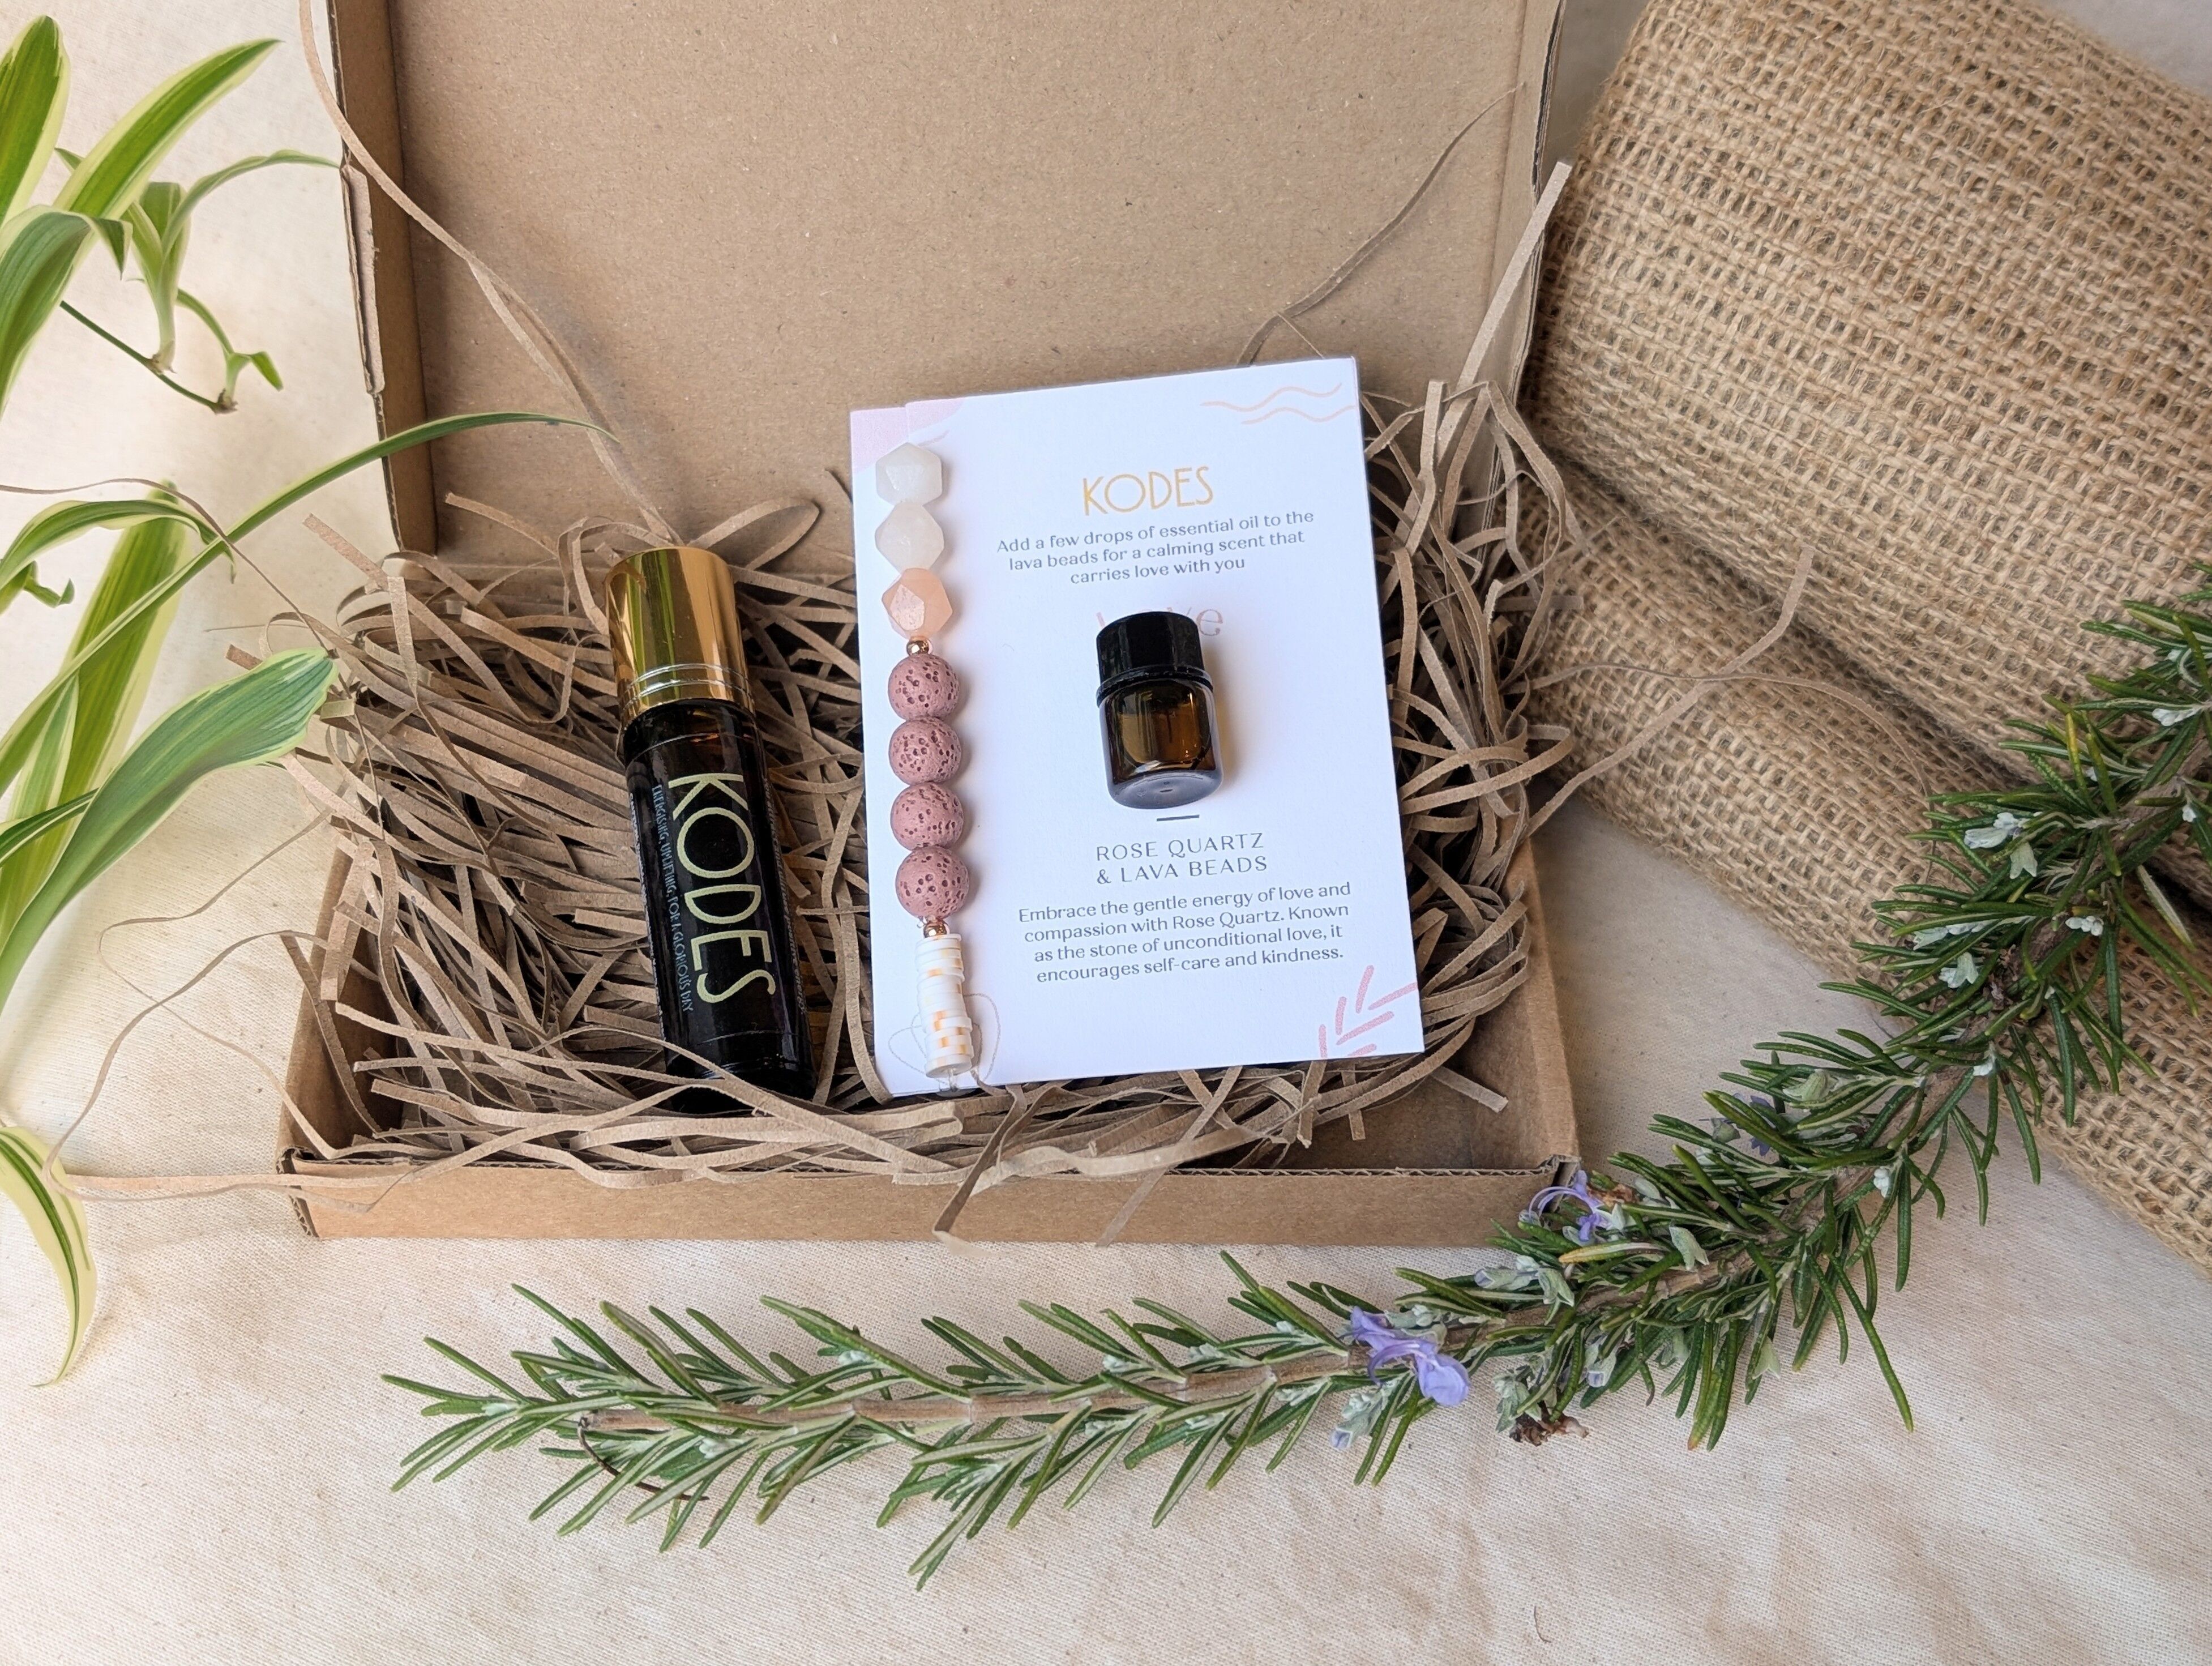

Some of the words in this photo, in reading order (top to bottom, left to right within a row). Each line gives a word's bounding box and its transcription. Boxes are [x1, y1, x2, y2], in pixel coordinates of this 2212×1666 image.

[1083, 467, 1213, 515] KODES
[996, 537, 1030, 553] Add
[1035, 539, 1045, 549] a
[1050, 535, 1080, 548] few
[1084, 531, 1133, 545] drops
[1137, 526, 1155, 540] of
[1159, 518, 1234, 538] essential
[1239, 515, 1259, 530] oil
[1264, 515, 1281, 527] to
[1286, 511, 1314, 525] the
[1009, 558, 1042, 571] lava
[1047, 550, 1098, 567] beads
[1102, 549, 1128, 562] for
[1132, 549, 1141, 559] a
[1146, 541, 1214, 558] calming
[1218, 535, 1266, 552] scent
[1269, 531, 1305, 546] that
[1070, 568, 1131, 584] carries
[1135, 565, 1169, 578] love
[1173, 559, 1210, 574] with
[1214, 558, 1245, 574] you
[1097, 841, 1158, 861] ROSE
[1168, 832, 1264, 858] QUARTZ
[668, 773, 776, 1003] KODES
[1097, 869, 1112, 885] &
[1120, 863, 1179, 883] LAVA
[1188, 856, 1267, 877] BEADS
[1019, 905, 1097, 922] Embrace
[1101, 900, 1129, 916] the
[1133, 895, 1187, 916] gentle
[1192, 893, 1253, 908] energy
[1257, 887, 1276, 903] of
[1278, 886, 1314, 900] love
[1318, 881, 1351, 898] and
[1024, 922, 1127, 943] compassion
[1131, 917, 1168, 933] with
[1173, 915, 1215, 929] Rose
[1219, 910, 1285, 929] Quartz.
[1288, 905, 1349, 920] Known
[1034, 951, 1054, 963] as
[1057, 945, 1085, 960] the
[1090, 943, 1138, 958] stone
[1142, 937, 1160, 953] of
[1163, 928, 1282, 951] unconditional
[1286, 927, 1327, 941] love,
[1330, 924, 1343, 938] it
[1037, 964, 1140, 983] encourages
[1144, 957, 1221, 974] self-care
[1225, 950, 1257, 967] and
[1261, 947, 1344, 964] kindness.
[681, 990, 694, 1012] DAY
